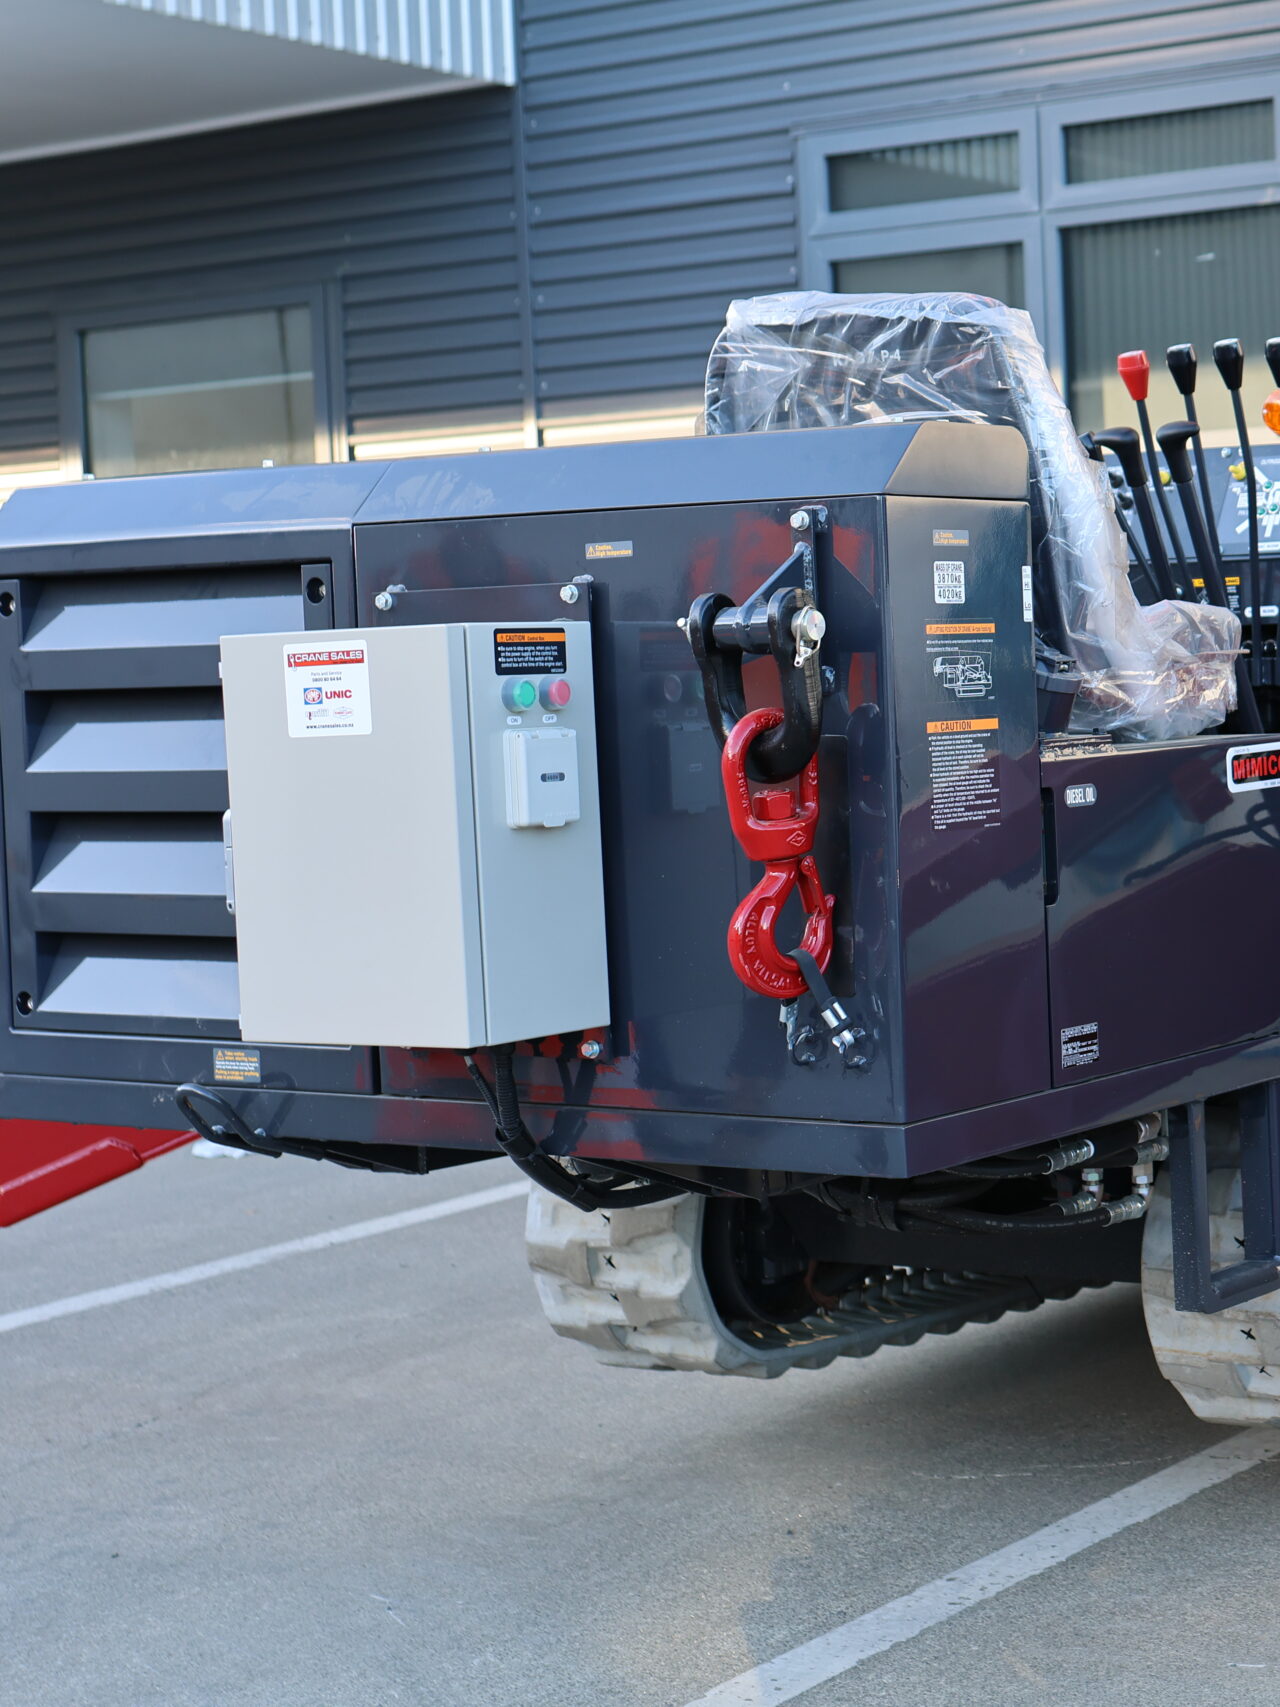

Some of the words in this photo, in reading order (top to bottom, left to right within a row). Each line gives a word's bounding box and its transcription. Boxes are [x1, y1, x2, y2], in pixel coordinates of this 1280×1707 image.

[935, 563, 945, 572] MASS
[946, 563, 950, 572] OF
[951, 563, 962, 572] CRANE
[938, 573, 962, 584] 3870kg
[938, 589, 962, 599] 4020kg
[295, 653, 330, 662] CRANE
[330, 651, 363, 660] SALES
[325, 689, 352, 700] UNIC
[940, 721, 972, 731] CAUTION
[1067, 789, 1085, 804] DIESEL
[1086, 787, 1095, 802] OIL
